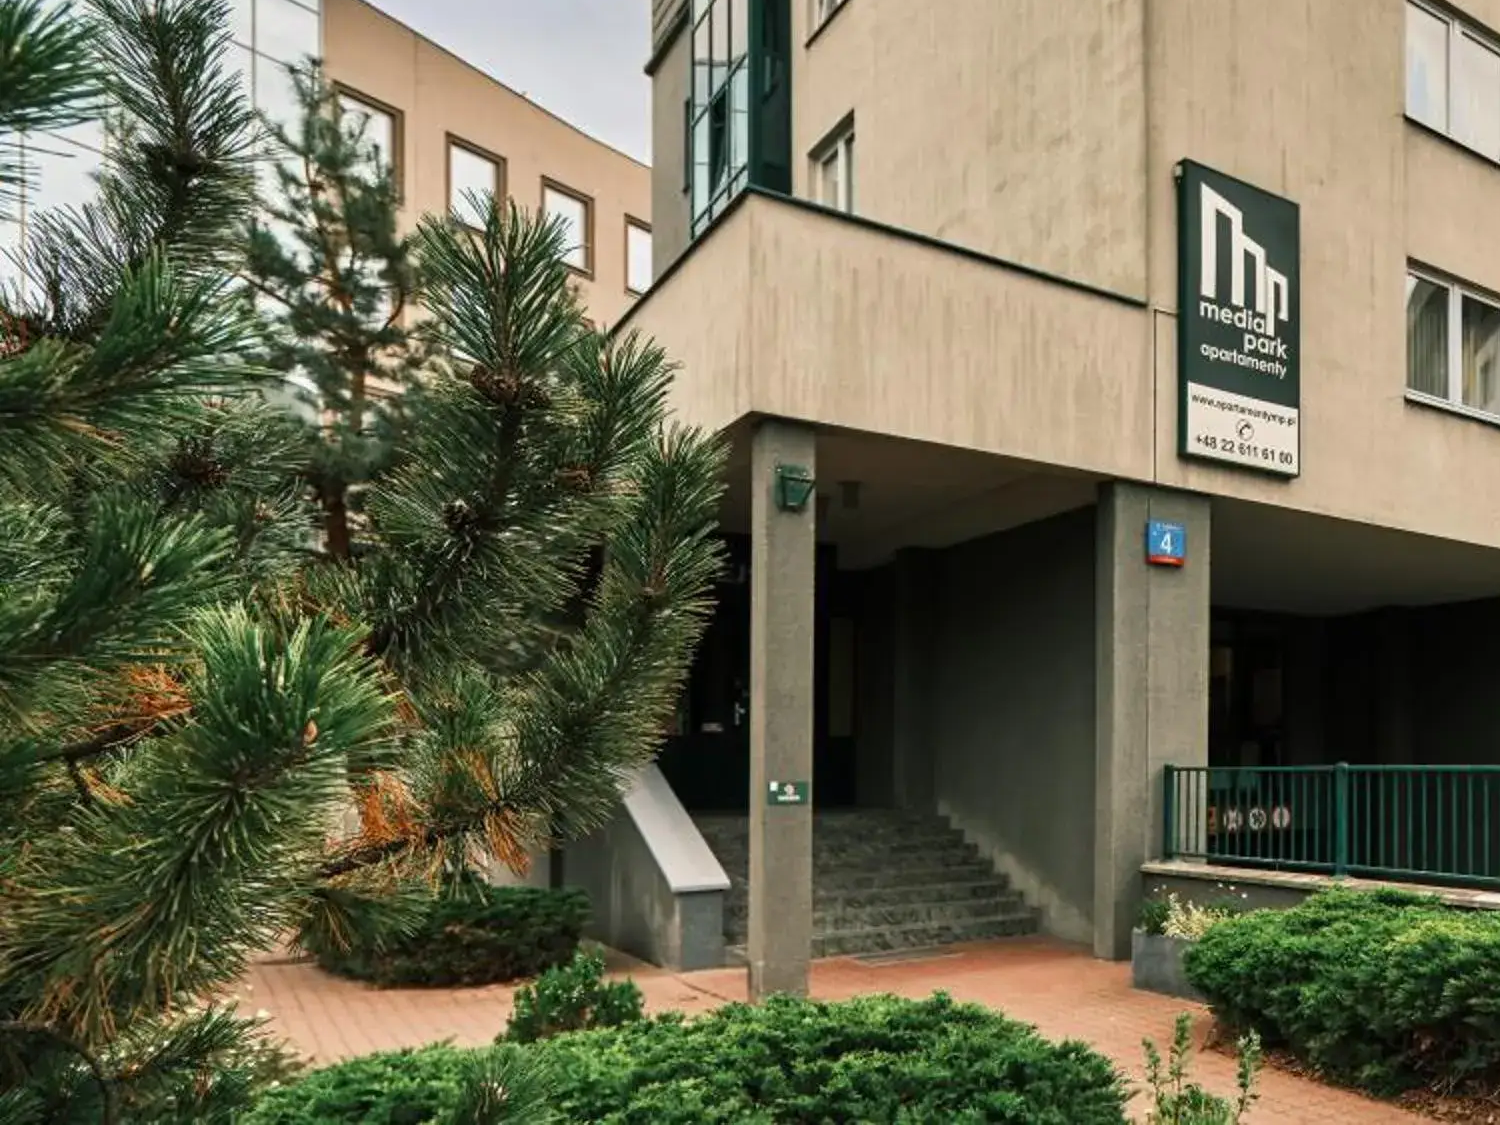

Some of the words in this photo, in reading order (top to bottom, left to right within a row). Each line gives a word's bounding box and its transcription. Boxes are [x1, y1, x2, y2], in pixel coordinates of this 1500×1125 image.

[1199, 301, 1264, 334] media
[1244, 332, 1288, 360] park
[1200, 343, 1287, 380] apartamenty
[1195, 434, 1217, 450] +48
[1220, 438, 1235, 454] 22
[1159, 531, 1172, 555] 4
